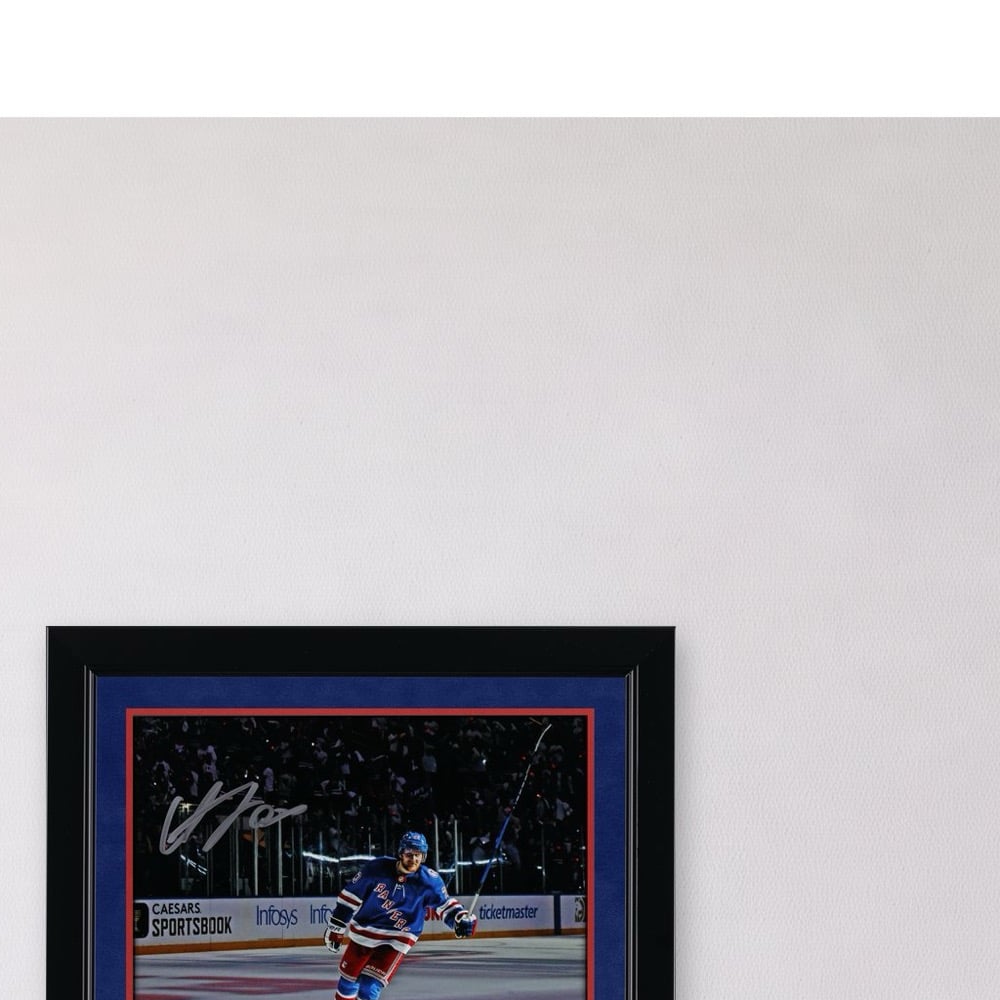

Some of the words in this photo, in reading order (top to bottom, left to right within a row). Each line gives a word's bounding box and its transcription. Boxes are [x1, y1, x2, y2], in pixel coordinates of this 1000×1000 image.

[152, 902, 201, 915] CAESARS
[256, 904, 298, 928] Infosys
[310, 904, 334, 925] Info
[373, 882, 411, 933] RANER
[479, 904, 539, 920] ticketmaster
[152, 916, 232, 937] SPORTSBOOK
